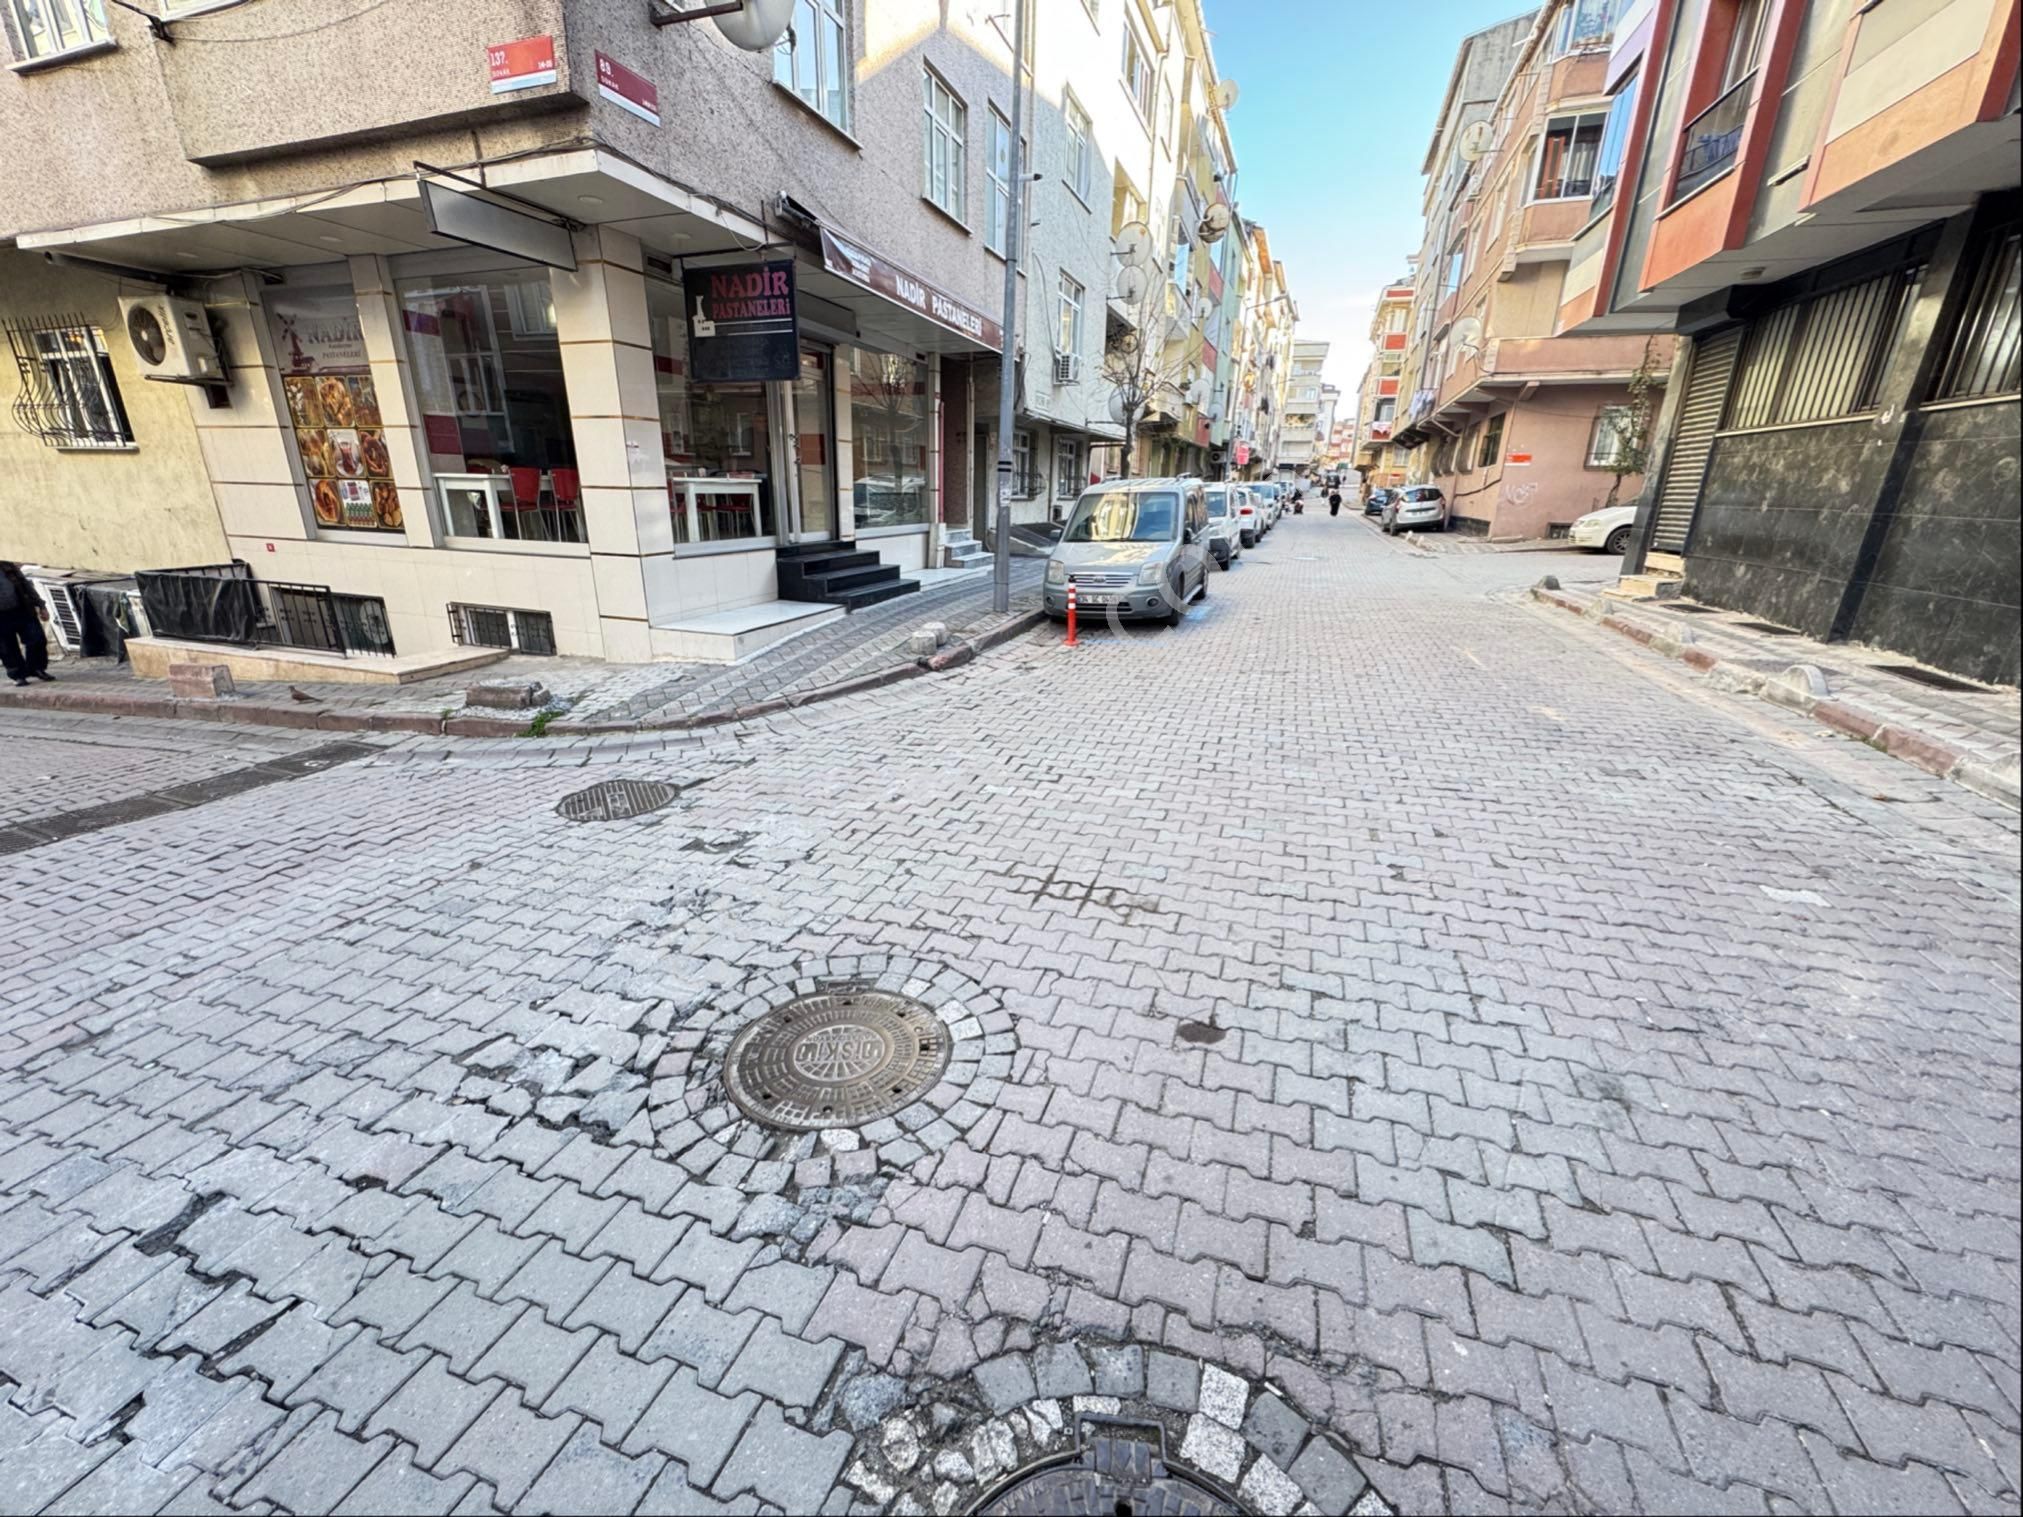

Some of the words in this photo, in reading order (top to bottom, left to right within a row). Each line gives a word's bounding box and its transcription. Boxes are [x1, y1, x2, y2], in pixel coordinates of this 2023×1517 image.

[490, 51, 509, 67] 137.
[599, 58, 614, 77] 89.
[710, 266, 789, 299] NADİR
[895, 274, 927, 310] NADİR
[931, 294, 983, 337] PASTANELERİ
